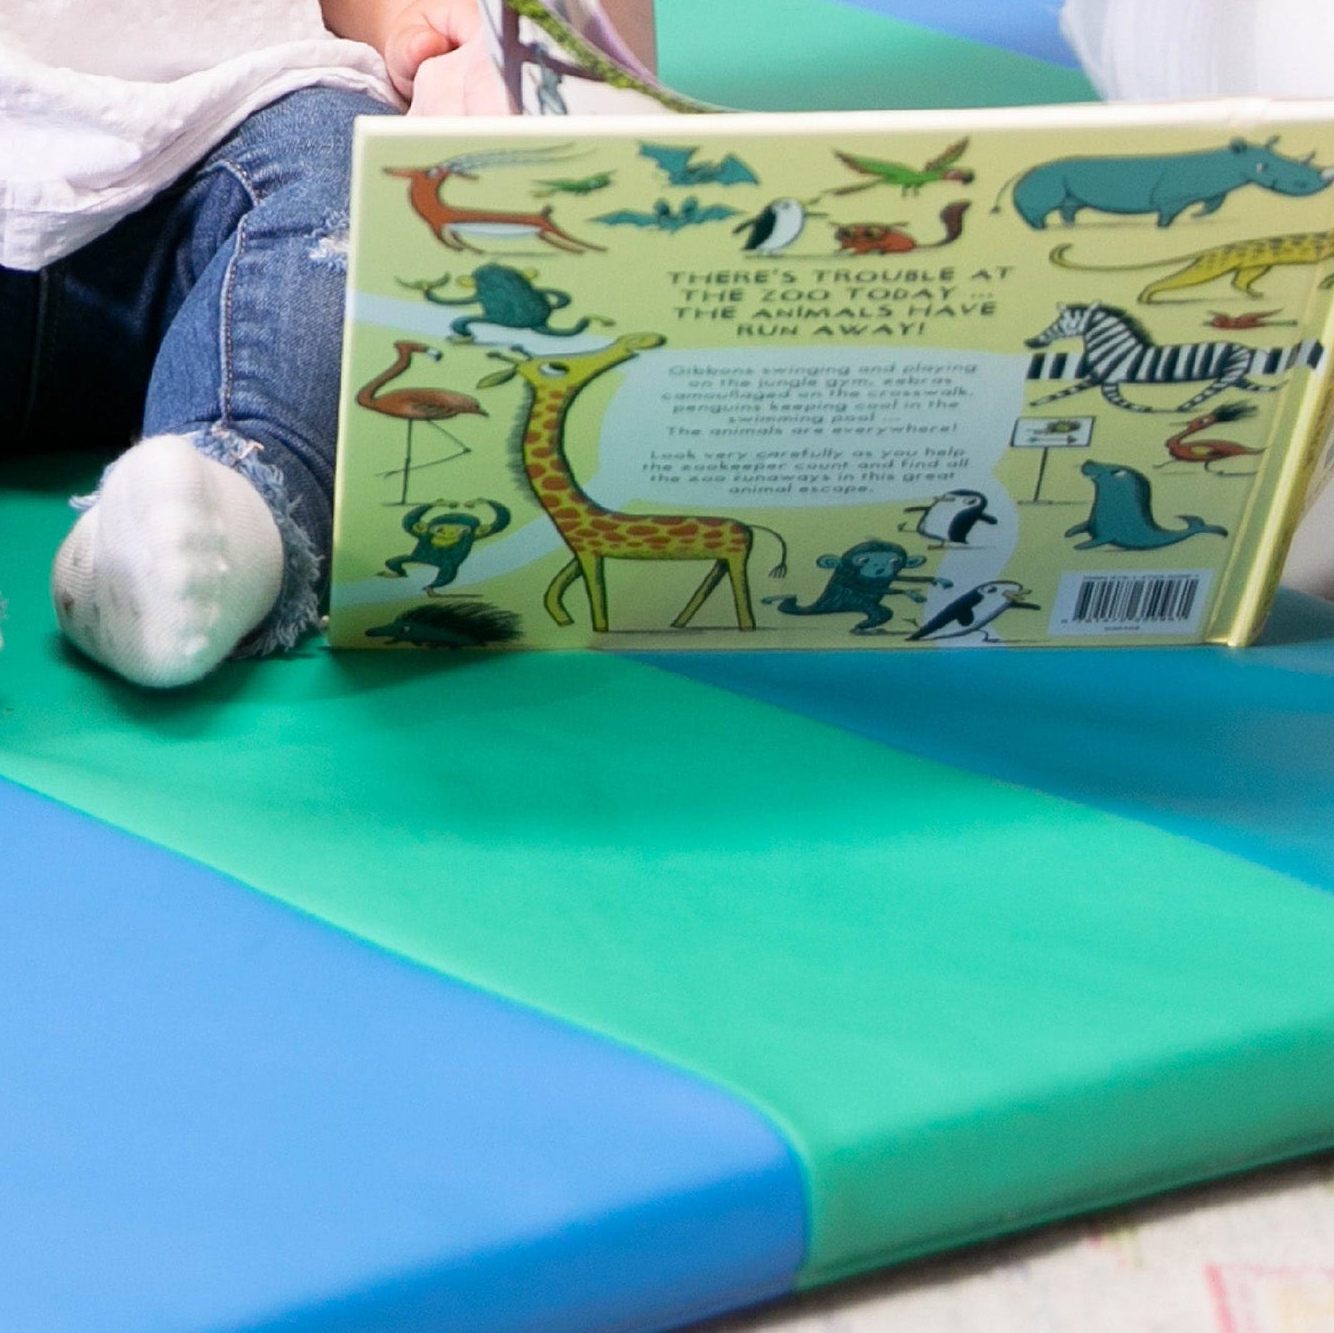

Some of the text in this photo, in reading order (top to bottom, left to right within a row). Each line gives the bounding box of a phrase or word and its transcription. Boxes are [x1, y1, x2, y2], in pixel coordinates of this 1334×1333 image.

[667, 266, 1015, 285] THERE'S TROUBLE AT
[681, 288, 745, 302] THE
[760, 289, 830, 302] ZOO
[847, 286, 958, 300] TODAY
[674, 301, 997, 320] THE ANIMALS HAVE
[737, 322, 925, 337] RUN AWAY!
[762, 364, 850, 375] swinging
[858, 363, 895, 373] and
[901, 361, 978, 374] playing
[719, 377, 750, 387] the
[758, 377, 817, 388] jungle
[660, 388, 790, 400] camouflaged
[828, 387, 859, 397] the
[672, 399, 959, 413] penguins keeping cool in the
[729, 413, 824, 424] swimming
[830, 412, 877, 424] pool
[666, 426, 701, 436] The
[709, 425, 783, 436] animals
[831, 423, 958, 436] everywhere!
[650, 449, 696, 459] Look
[704, 451, 747, 460] very
[755, 448, 843, 460] carefully
[881, 450, 919, 459] you
[924, 446, 966, 458] help
[642, 458, 969, 472] the zookeeper count and find all
[650, 471, 955, 483] the zoo runaways in this great
[729, 483, 873, 495] animal escape.
